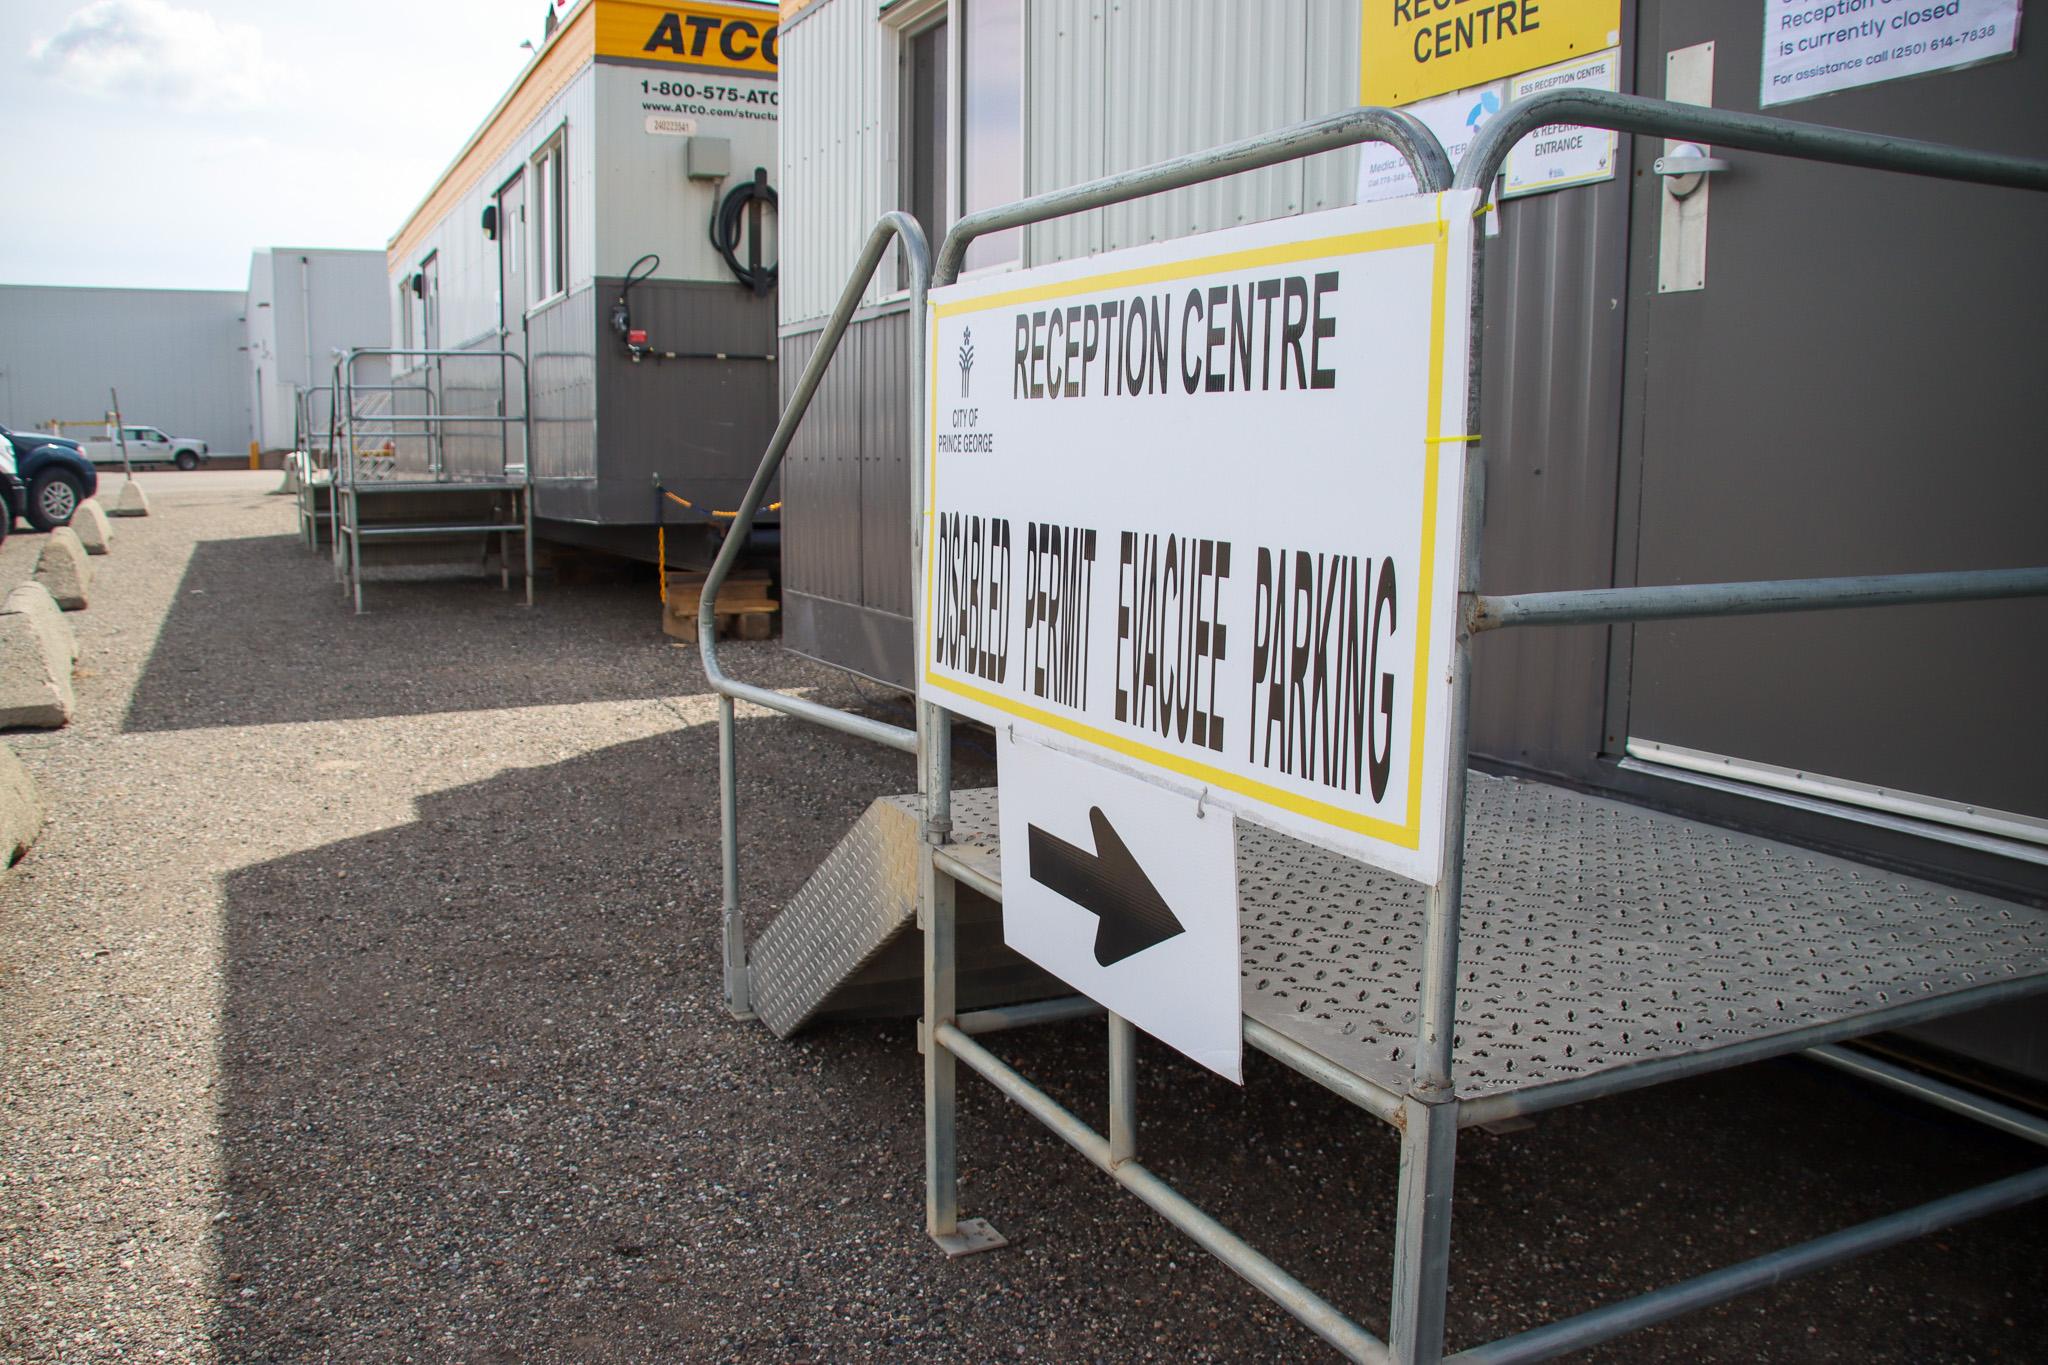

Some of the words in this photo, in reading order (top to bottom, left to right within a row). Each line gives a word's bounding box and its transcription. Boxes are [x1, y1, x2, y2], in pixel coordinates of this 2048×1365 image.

[1414, 0, 1540, 63] CENTRE
[1773, 74, 1794, 86] For
[1796, 58, 1863, 81] assistance
[1866, 50, 1889, 66] call
[1892, 42, 1927, 60] (250)
[1930, 25, 1996, 51] 614-7838
[1780, 41, 1794, 57] is
[1798, 17, 1885, 52] currently
[1891, 0, 1961, 29] closed
[1521, 83, 1534, 95] ESS
[1535, 72, 1576, 91] RECEPTION
[1576, 64, 1606, 80] CENTRE
[1534, 135, 1583, 157] ENTRANCE
[1014, 293, 1171, 399] RECEPTION
[1181, 271, 1339, 395] CENTRE
[938, 434, 962, 453] PRINCE
[963, 433, 993, 453] GEORGE
[952, 409, 968, 428] CITY
[969, 408, 979, 428] OF
[936, 511, 1011, 684] DISABLED
[1022, 521, 1097, 712] PERMIT
[1115, 530, 1232, 753] EVACUEE
[1249, 546, 1397, 804] PARKING
